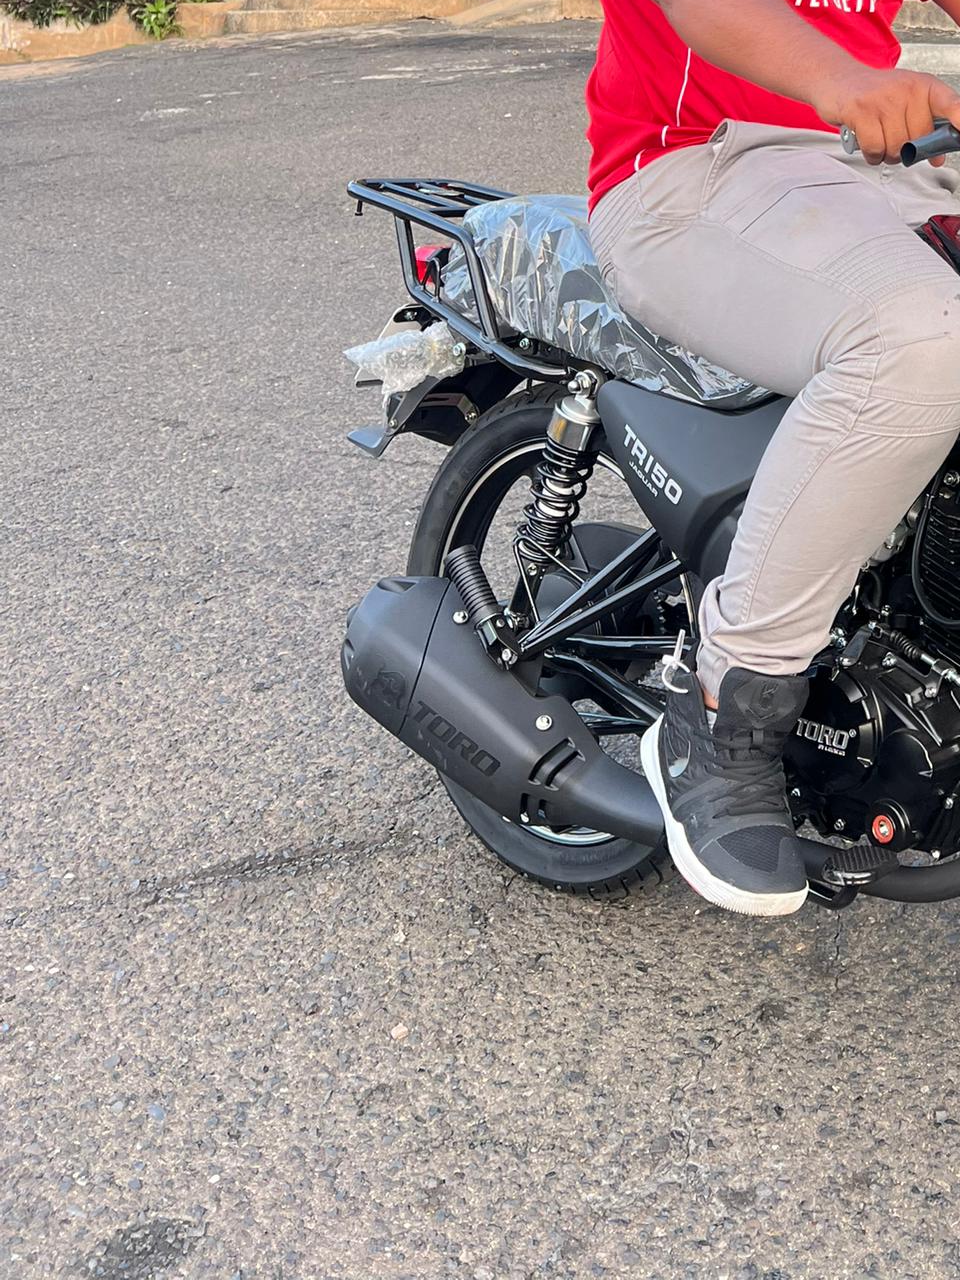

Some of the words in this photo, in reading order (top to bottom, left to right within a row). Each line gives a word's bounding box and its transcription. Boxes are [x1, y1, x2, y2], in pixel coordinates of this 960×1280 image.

[623, 423, 683, 505] TR150
[628, 460, 659, 497] JAGUAR
[412, 700, 501, 777] TORO
